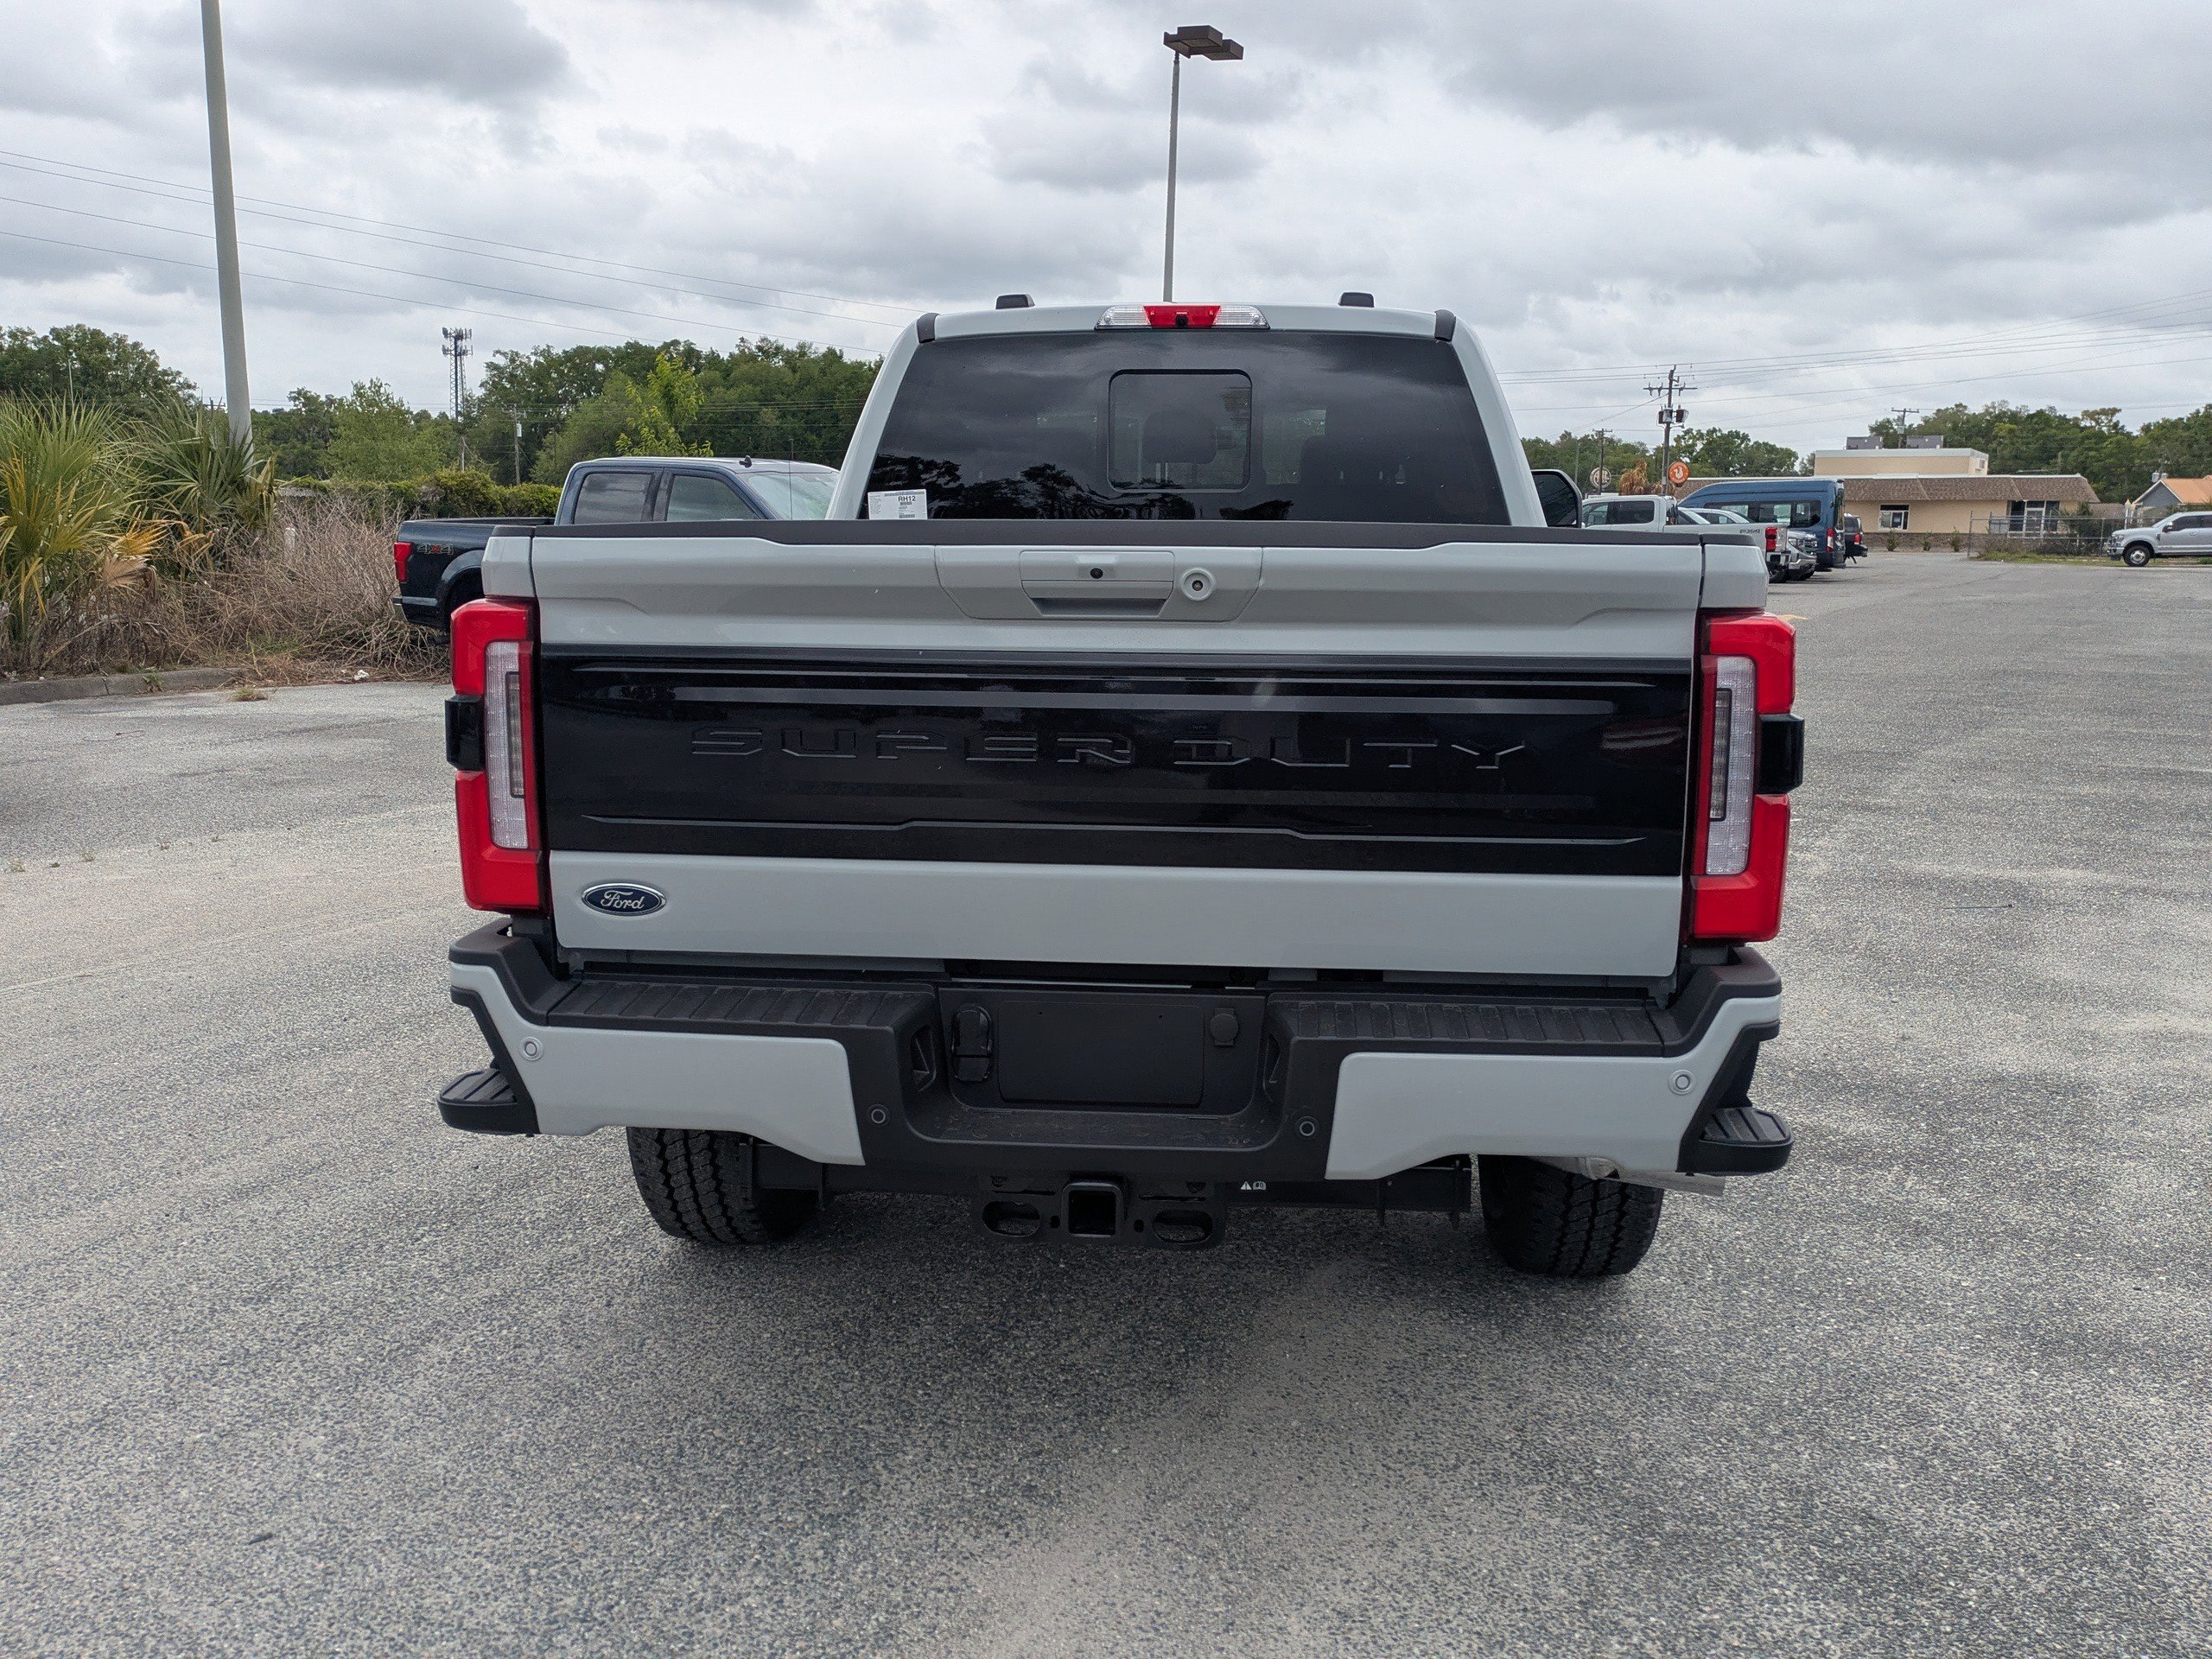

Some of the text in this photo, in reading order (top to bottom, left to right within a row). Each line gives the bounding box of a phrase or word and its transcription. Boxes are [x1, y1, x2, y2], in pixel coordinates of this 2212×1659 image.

[690, 725, 1527, 770] SUPER DUTY
[601, 890, 645, 909] Ford
